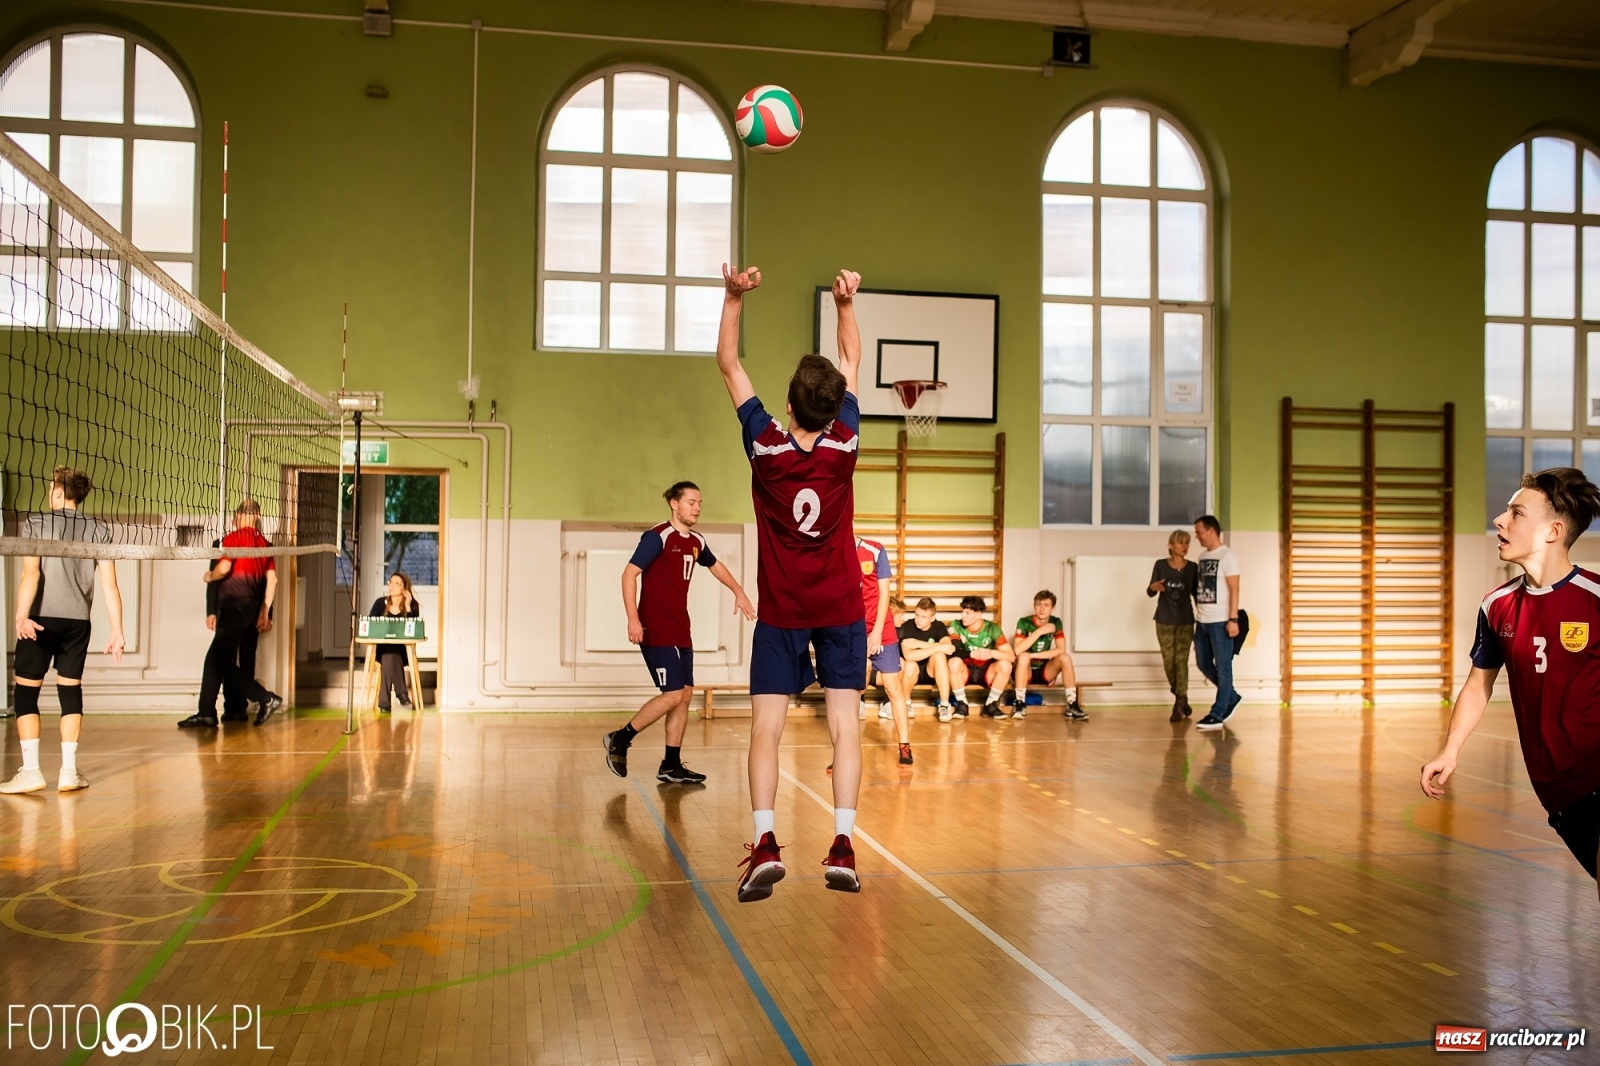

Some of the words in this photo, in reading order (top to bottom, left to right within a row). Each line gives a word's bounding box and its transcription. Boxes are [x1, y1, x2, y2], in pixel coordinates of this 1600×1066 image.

[792, 487, 821, 538] 2
[683, 554, 694, 580] 17
[1533, 636, 1548, 674] 3
[656, 667, 667, 687] 17
